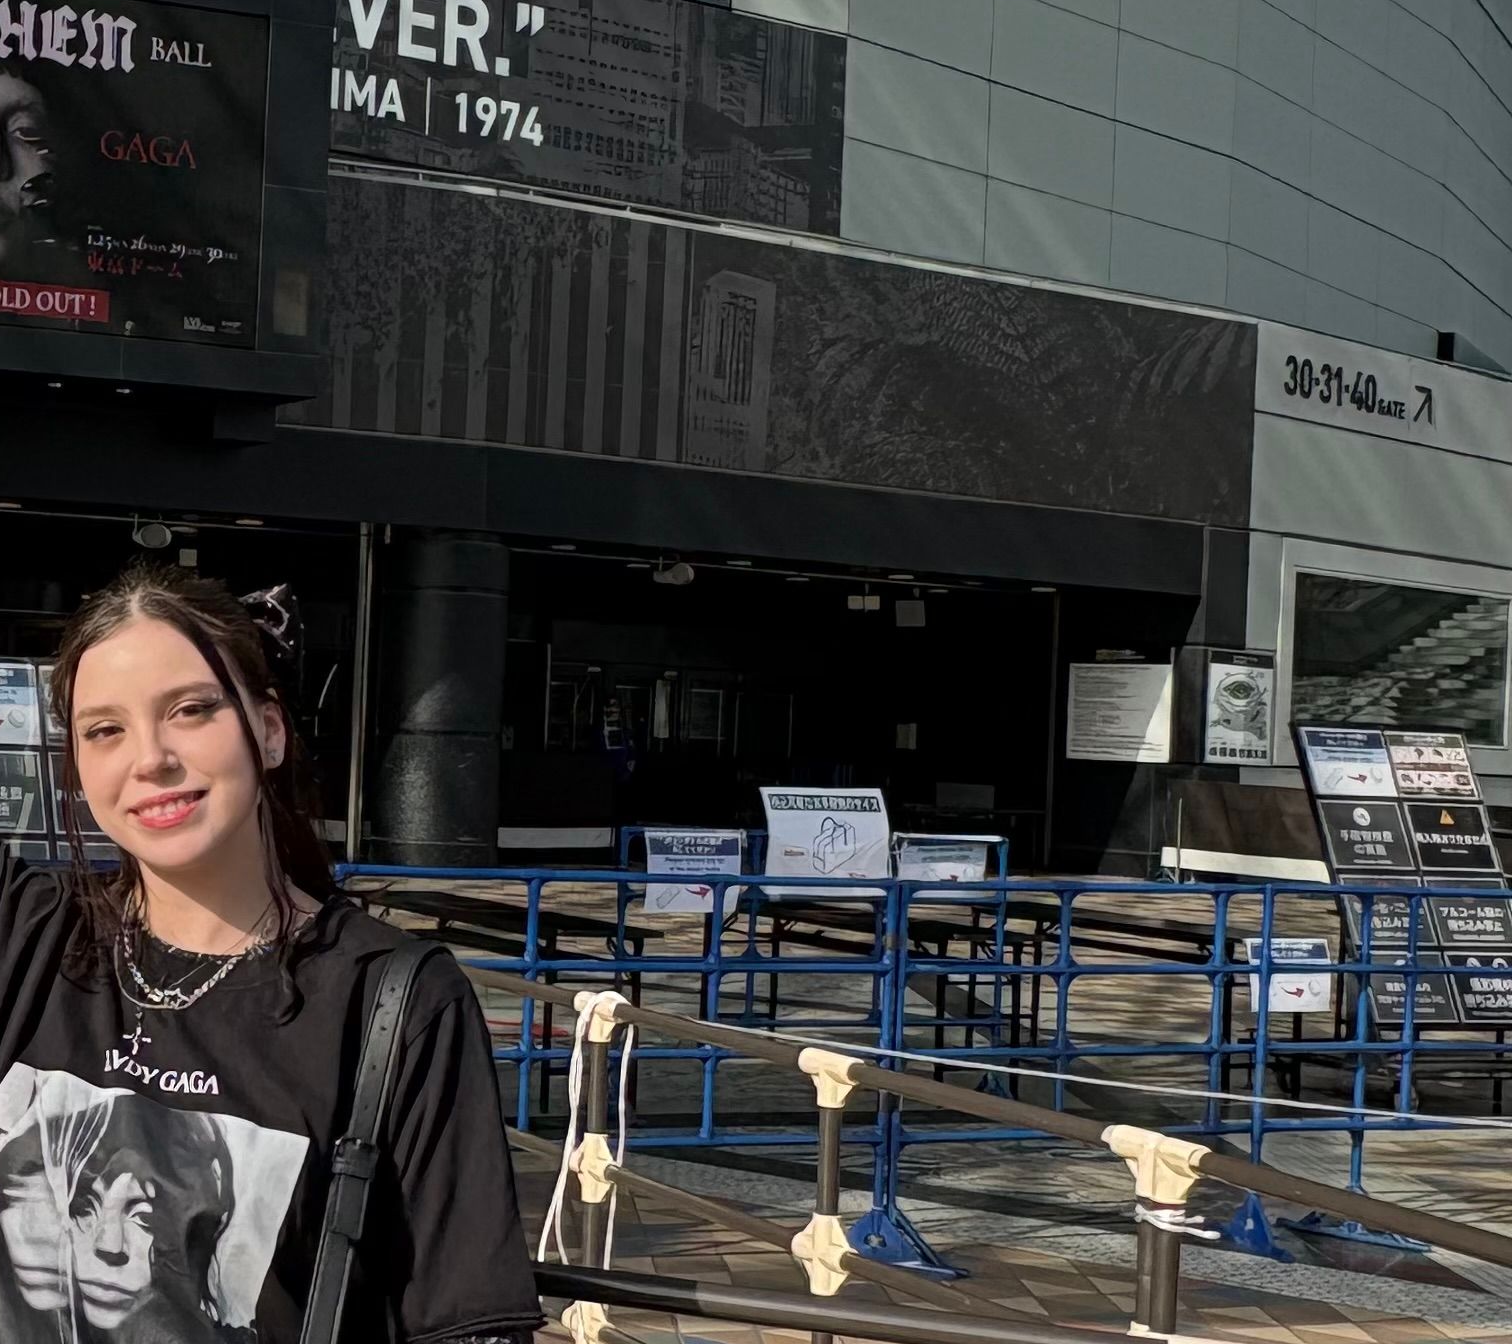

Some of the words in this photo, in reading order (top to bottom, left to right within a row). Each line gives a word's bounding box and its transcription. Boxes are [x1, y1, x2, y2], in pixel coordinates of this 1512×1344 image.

[150, 36, 212, 67] BALL
[455, 92, 544, 146] 1974
[100, 130, 196, 169] GAGA
[1377, 398, 1406, 419] GATE
[159, 1069, 220, 1095] GAGA
